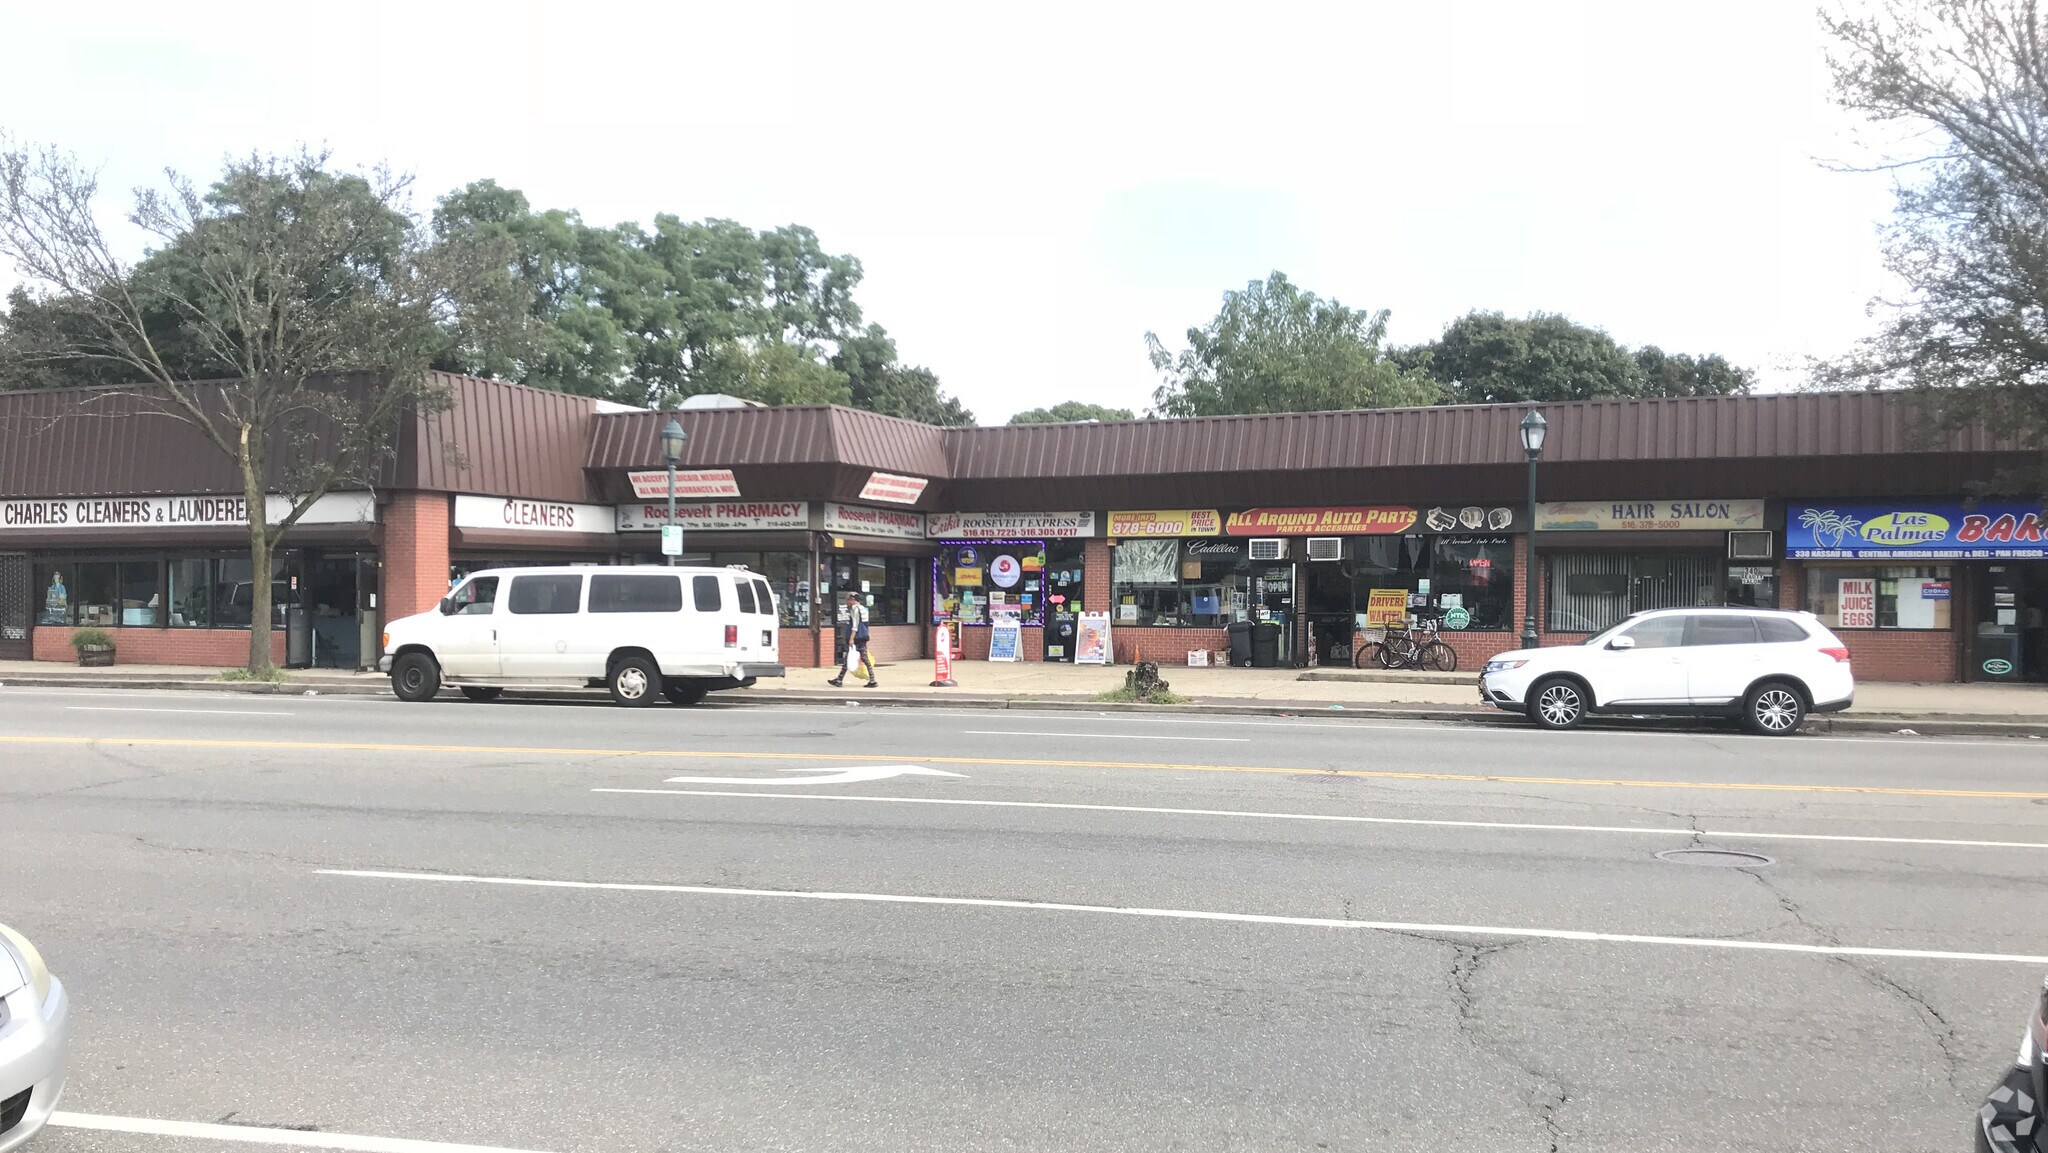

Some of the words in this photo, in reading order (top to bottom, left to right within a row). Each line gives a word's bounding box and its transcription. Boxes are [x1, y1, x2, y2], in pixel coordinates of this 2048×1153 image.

[4, 502, 68, 525] CHARLES
[76, 500, 151, 523] CLEANERS
[155, 507, 164, 519] &
[169, 498, 250, 521] LAUNDERE
[504, 503, 574, 527] CLEANERS
[716, 503, 801, 518] PHARMACY
[838, 506, 877, 524] Roosevelt
[878, 511, 920, 528] PHARMACY
[1113, 514, 1136, 522] MORE
[1137, 513, 1156, 522] INFO
[1191, 511, 1211, 519] BEST
[1612, 504, 1655, 519] HAIR
[1671, 503, 1730, 519] SALON
[962, 518, 1024, 528] ROOSEVELT
[1027, 517, 1077, 528] EXPRESS
[1191, 519, 1215, 527] PRICE
[1227, 513, 1252, 527] ALL
[1257, 512, 1318, 526] AROUND
[1321, 511, 1361, 525] AUTO
[1366, 509, 1418, 524] PARTS
[1112, 522, 1183, 535] 378-6000
[1863, 526, 1946, 542] Palmas
[1891, 512, 1927, 526] Las
[1956, 513, 2048, 542] BAK
[1186, 540, 1239, 556] Cadillac
[1469, 559, 1491, 567] OPEN
[1268, 581, 1288, 593] OPEN
[1843, 581, 1873, 595] MILK
[1370, 597, 1405, 607] DRIVERS
[1842, 597, 1873, 611] JUICE
[1842, 612, 1874, 626] EGGS
